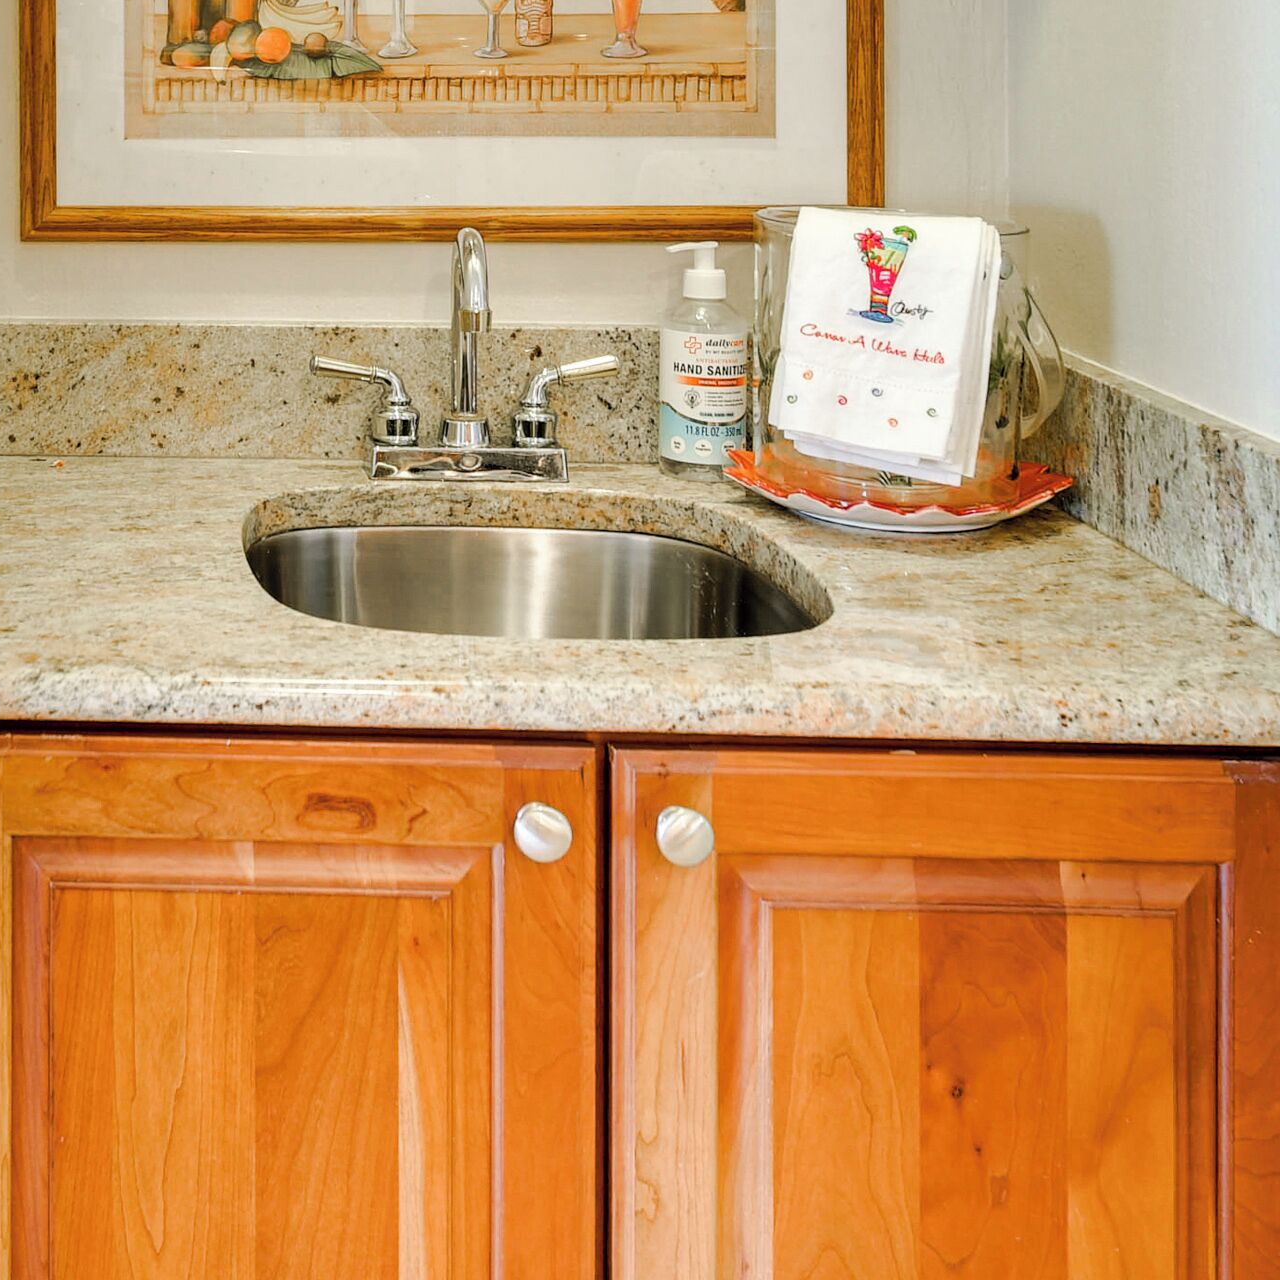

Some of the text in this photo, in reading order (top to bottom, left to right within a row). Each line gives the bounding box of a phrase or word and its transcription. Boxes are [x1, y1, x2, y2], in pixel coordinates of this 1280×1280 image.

[673, 362, 703, 375] HAND
[702, 425, 708, 436] FL
[710, 425, 720, 437] OZ
